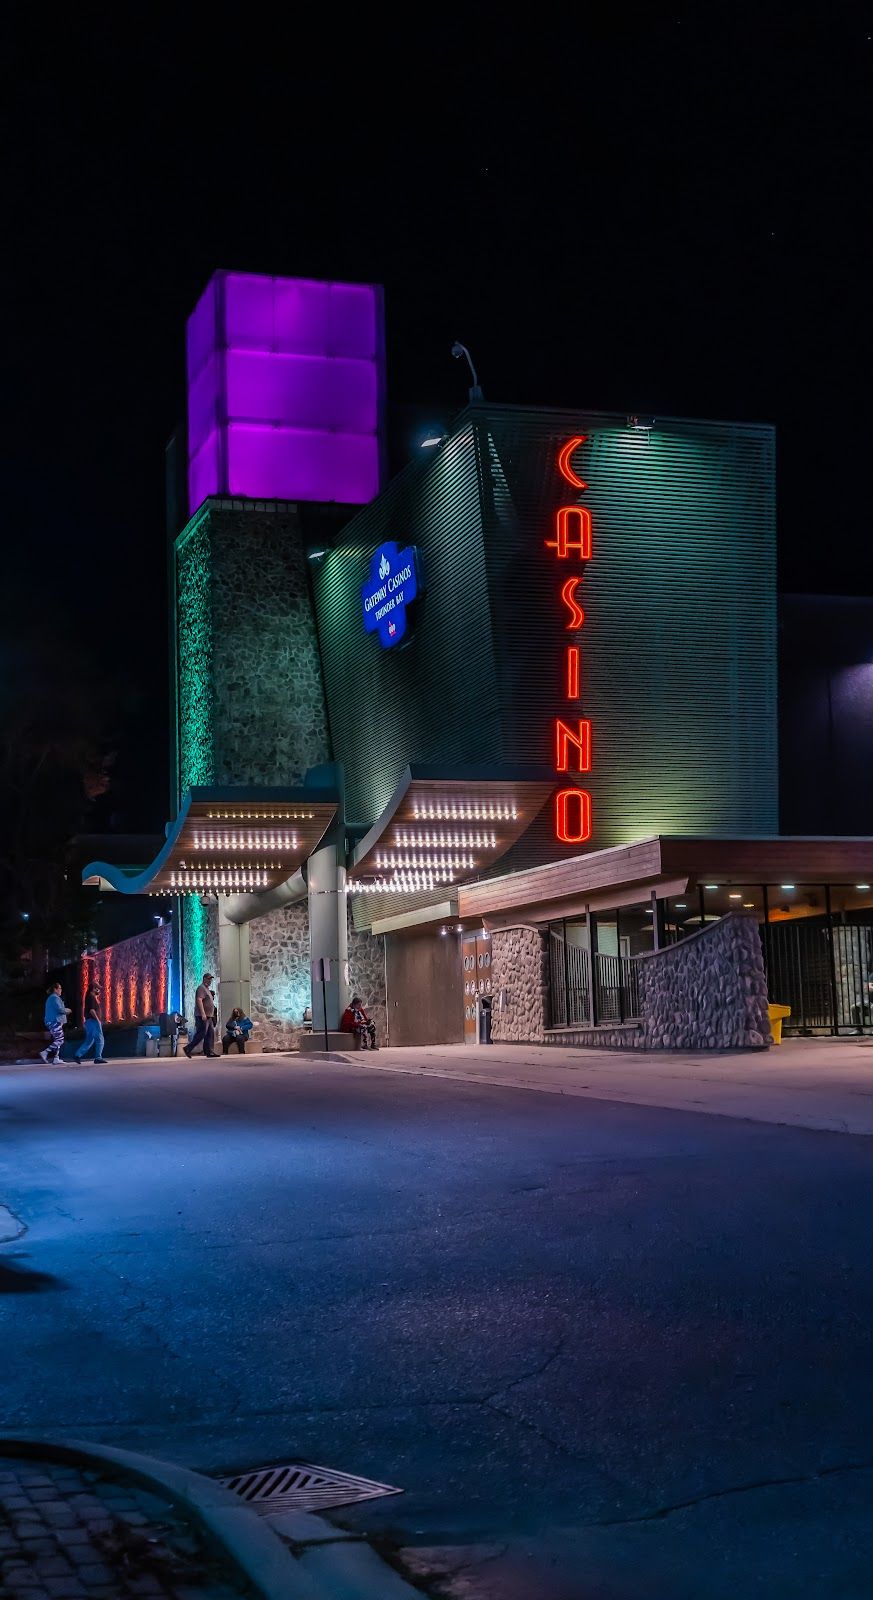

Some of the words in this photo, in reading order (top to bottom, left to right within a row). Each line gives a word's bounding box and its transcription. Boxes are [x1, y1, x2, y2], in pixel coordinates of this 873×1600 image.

[364, 585, 387, 612] GATEWAY
[388, 565, 412, 592] CASINOS
[375, 599, 396, 621] THUNDER
[395, 591, 404, 605] BAY
[545, 435, 592, 843] CASINO
